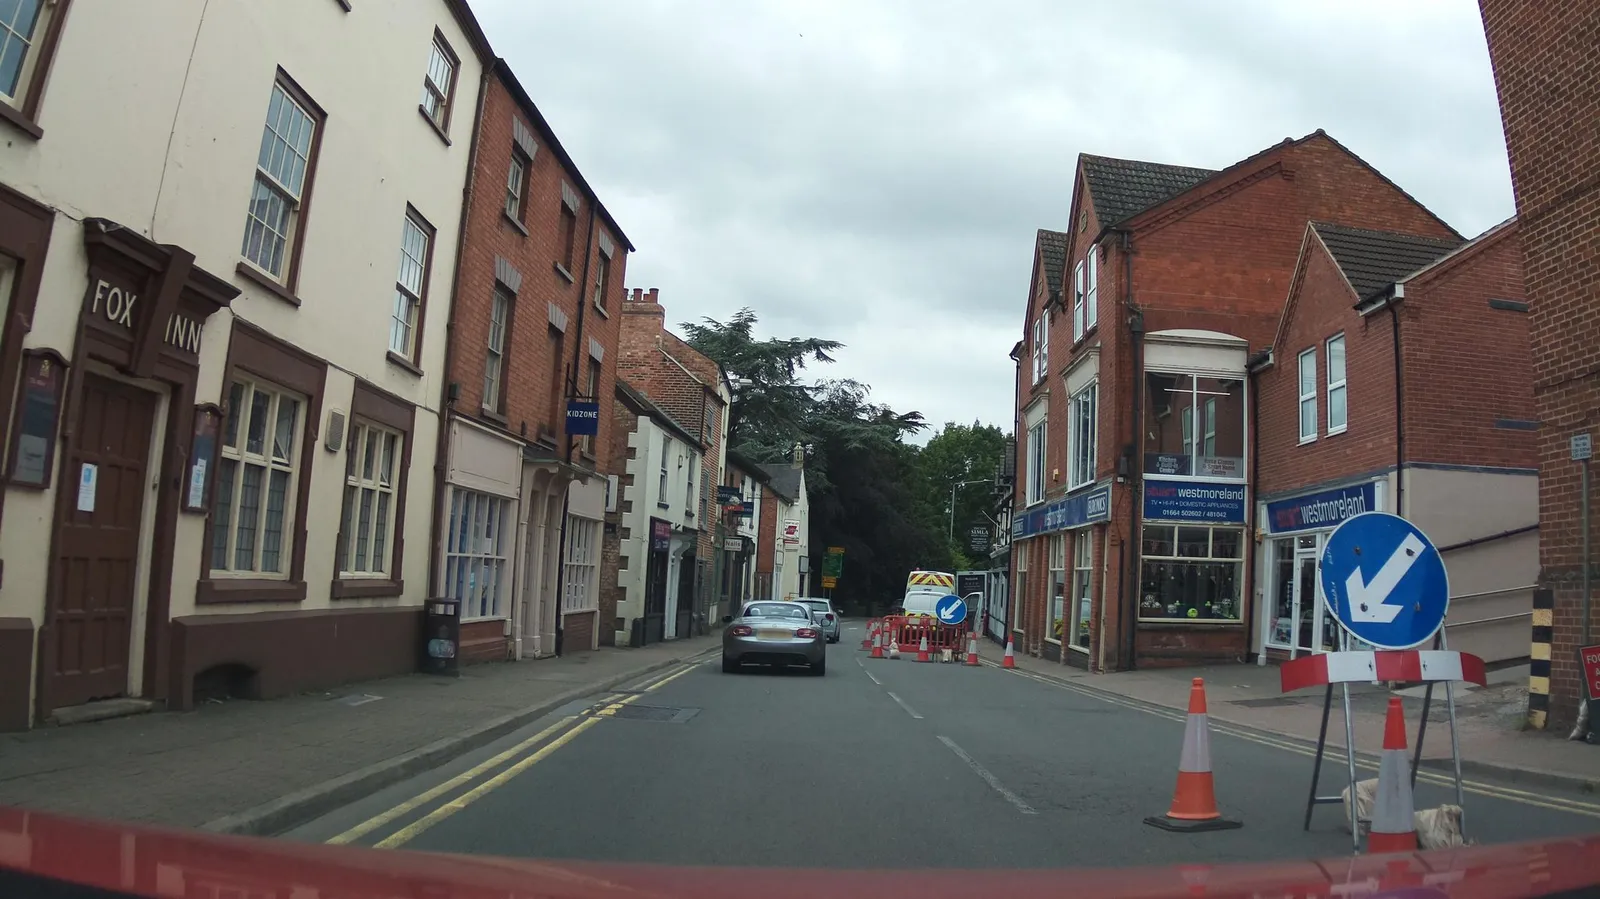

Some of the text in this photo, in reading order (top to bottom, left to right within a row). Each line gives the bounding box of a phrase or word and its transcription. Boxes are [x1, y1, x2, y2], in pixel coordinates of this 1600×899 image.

[92, 279, 201, 353] FOX INN
[566, 410, 598, 419] KIDZONE
[1178, 488, 1243, 500] westmoreland
[1300, 487, 1366, 525] westmoreland
